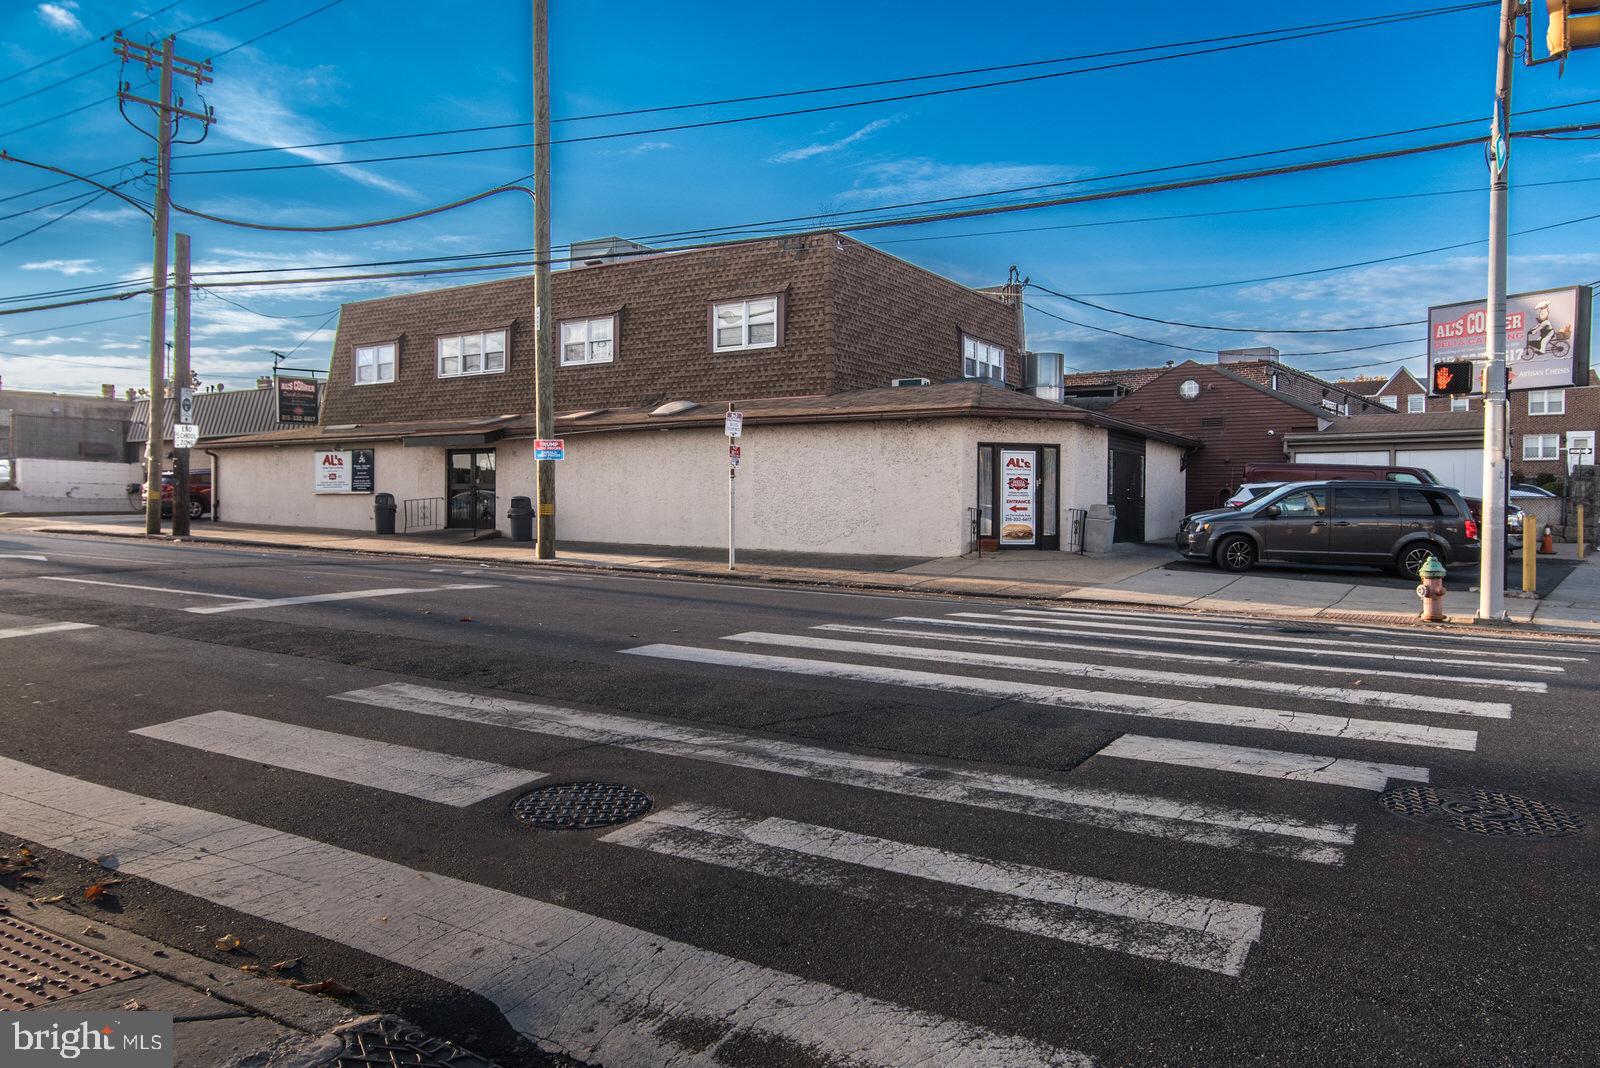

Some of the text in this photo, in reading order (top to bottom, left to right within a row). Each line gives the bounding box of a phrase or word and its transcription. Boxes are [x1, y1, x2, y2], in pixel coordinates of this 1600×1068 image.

[1436, 311, 1522, 338] AL'S COER
[1434, 340, 1457, 349] DELI
[293, 380, 316, 392] CORNER
[323, 454, 343, 466] AL's
[1006, 457, 1032, 468] AL's
